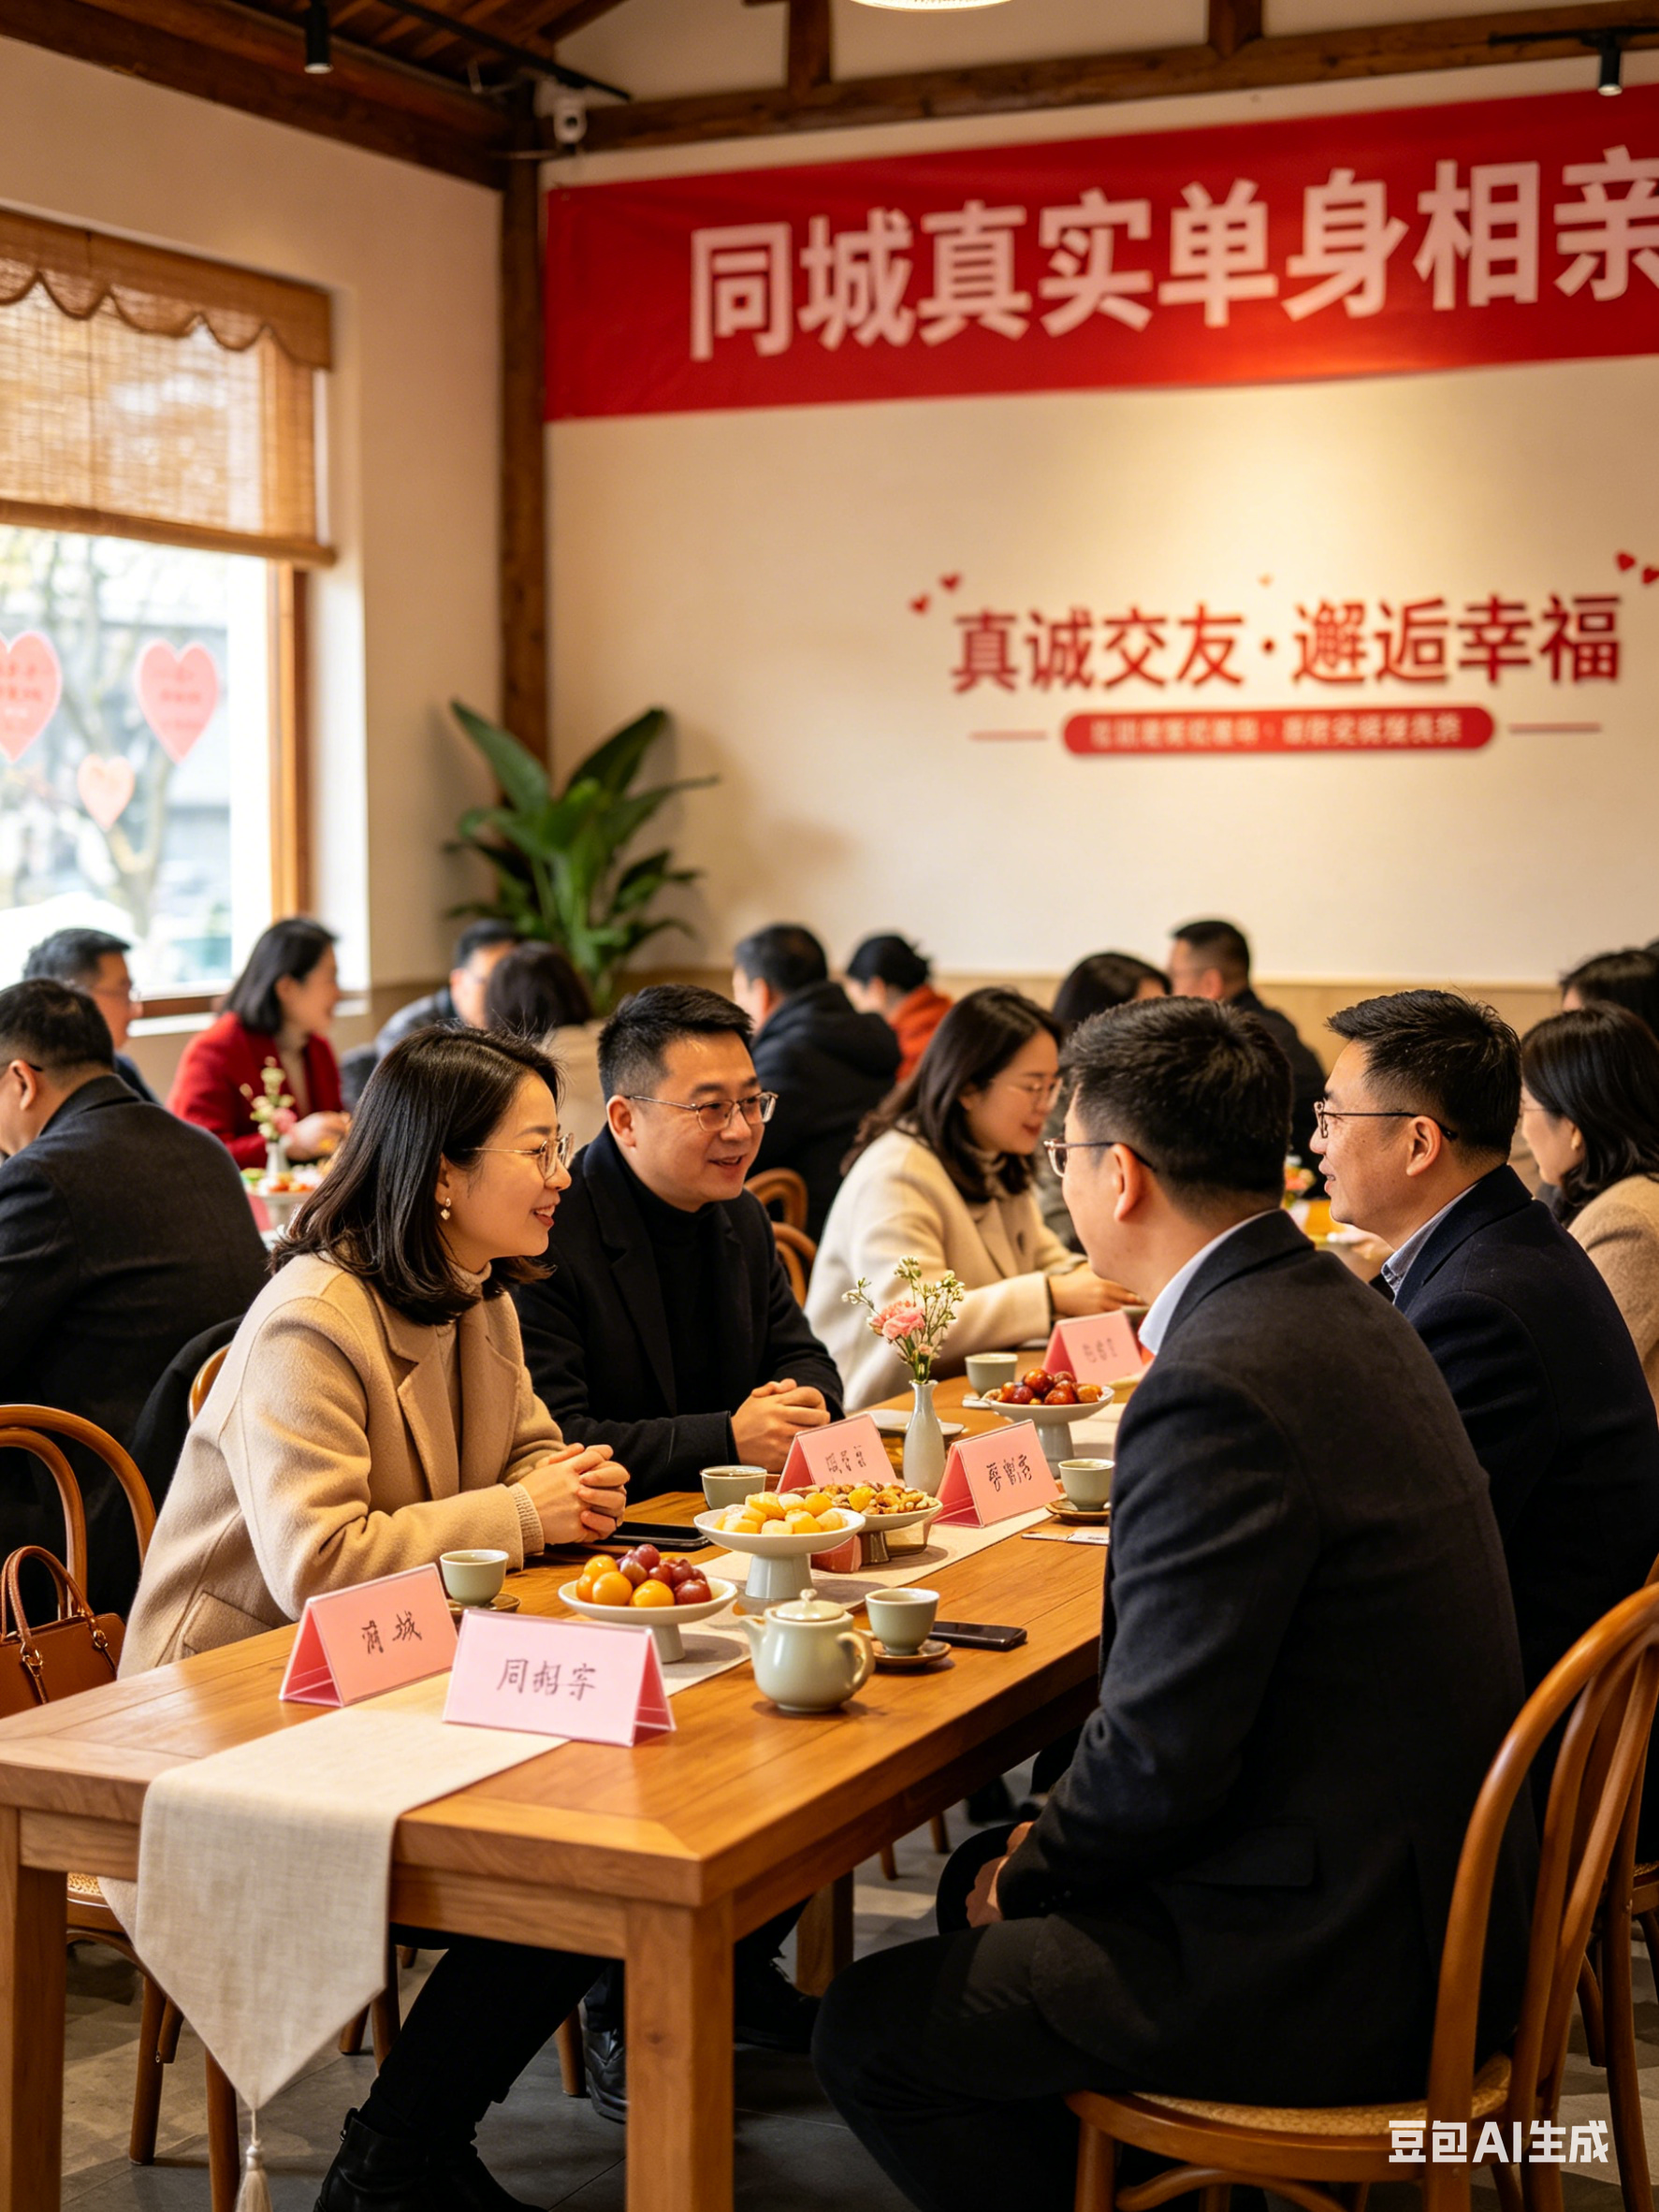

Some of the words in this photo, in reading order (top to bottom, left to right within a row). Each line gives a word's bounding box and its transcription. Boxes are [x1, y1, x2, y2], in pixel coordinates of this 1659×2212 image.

[691, 144, 1659, 361] 同城真实单身相亲
[952, 593, 1623, 694] 真诚交友·邂逅幸福
